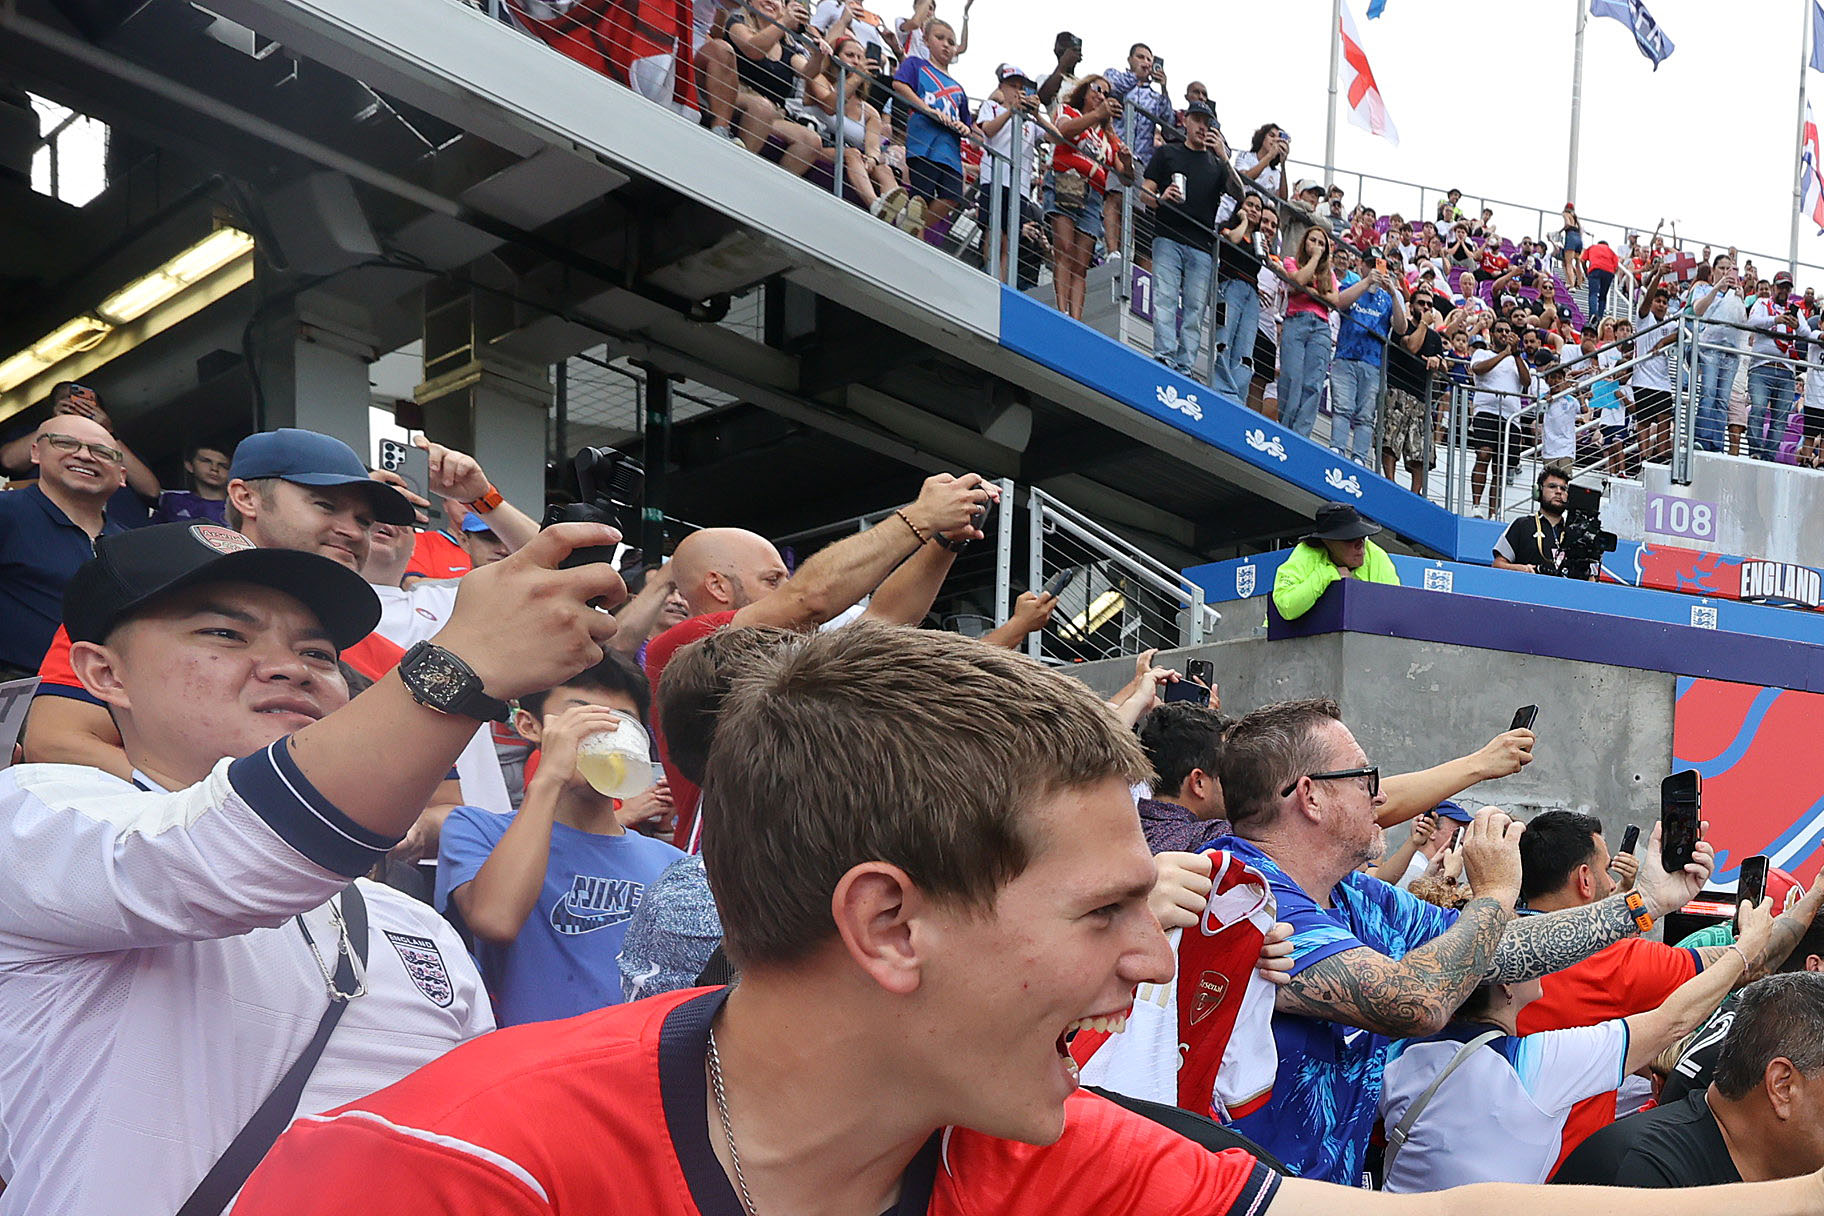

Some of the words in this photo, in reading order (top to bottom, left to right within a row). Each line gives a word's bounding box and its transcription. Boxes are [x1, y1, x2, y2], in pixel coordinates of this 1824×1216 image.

[1650, 498, 1713, 537] 108
[1740, 561, 1821, 608] ENGLAND
[567, 875, 645, 912] NIKE
[389, 934, 432, 949] ENGLAND
